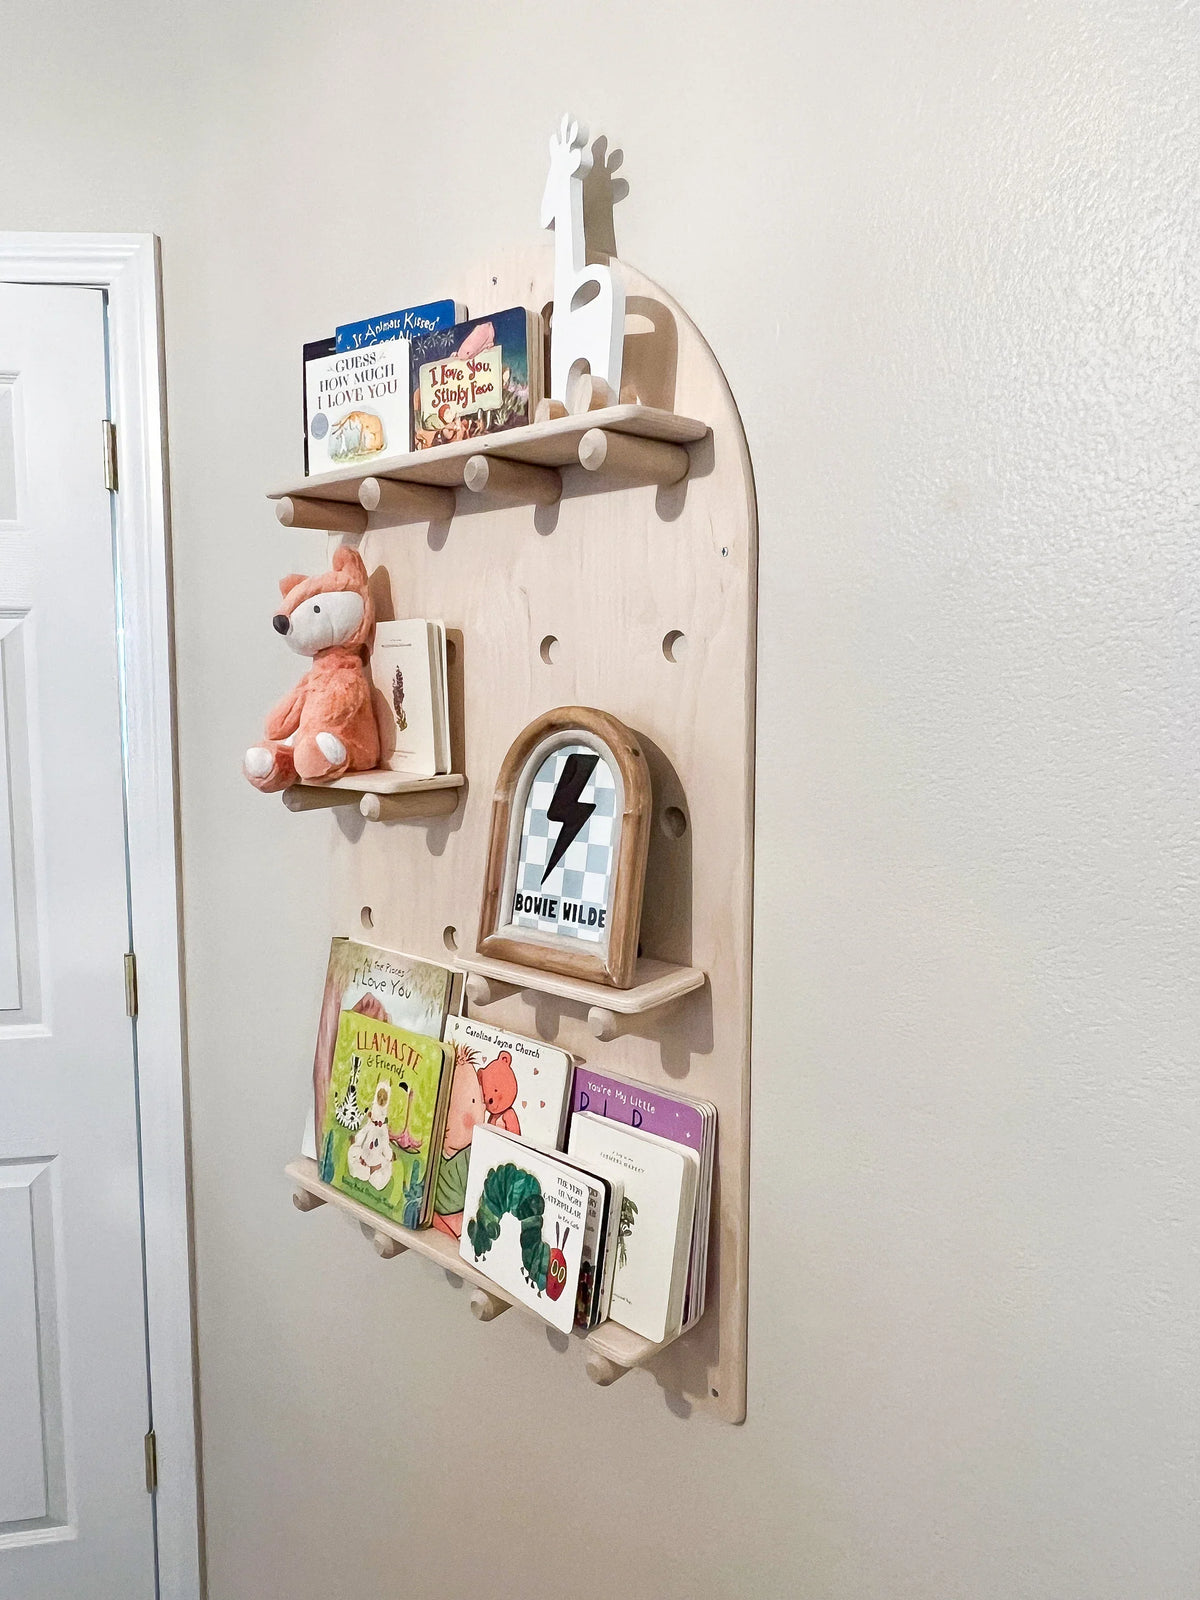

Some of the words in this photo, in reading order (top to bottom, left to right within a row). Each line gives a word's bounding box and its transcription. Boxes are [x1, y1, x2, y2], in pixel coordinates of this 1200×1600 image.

[364, 319, 401, 341] Animals
[403, 312, 440, 332] Kissed
[335, 351, 377, 373] GUESS
[429, 366, 438, 388] I
[440, 364, 464, 386] Love
[319, 373, 350, 393] HOW
[354, 363, 394, 385] MUCH
[318, 396, 322, 410] I
[327, 387, 364, 408] LOVE
[367, 379, 397, 399] YOU
[431, 384, 469, 409] Stinky
[514, 893, 558, 919] BOWIE
[562, 902, 607, 929] WILDE
[361, 966, 387, 993] Love
[390, 979, 412, 999] You
[357, 1031, 424, 1076] LLAMASTE
[465, 1025, 492, 1043] Caroline
[493, 1035, 513, 1050] Jayne
[515, 1042, 540, 1059] Church
[375, 1054, 405, 1080] Friends
[587, 1081, 612, 1097] You're
[615, 1089, 627, 1105] My
[630, 1095, 656, 1114] Little
[557, 1177, 568, 1190] THE
[569, 1183, 583, 1197] VERY
[558, 1188, 582, 1208] HUNGRY
[543, 1192, 582, 1220] CATERPILLAR
